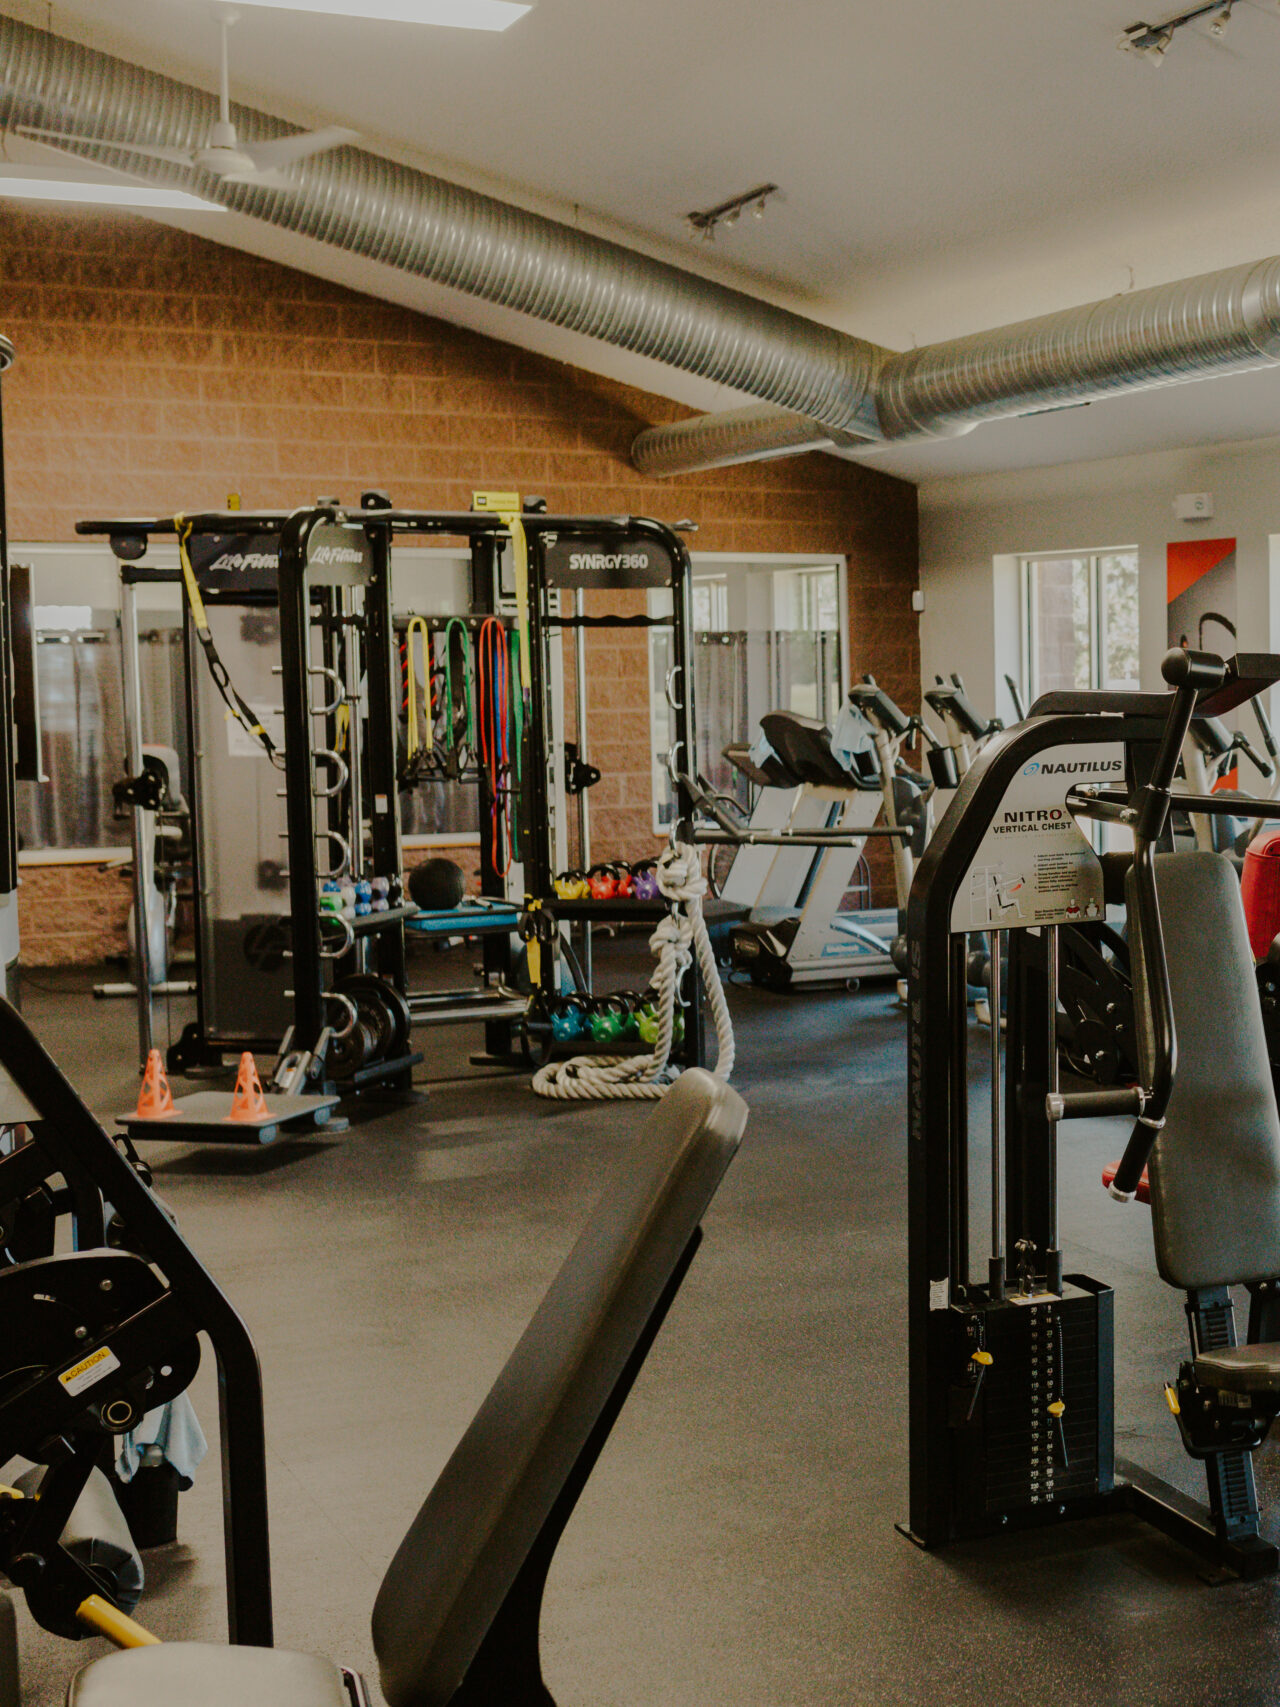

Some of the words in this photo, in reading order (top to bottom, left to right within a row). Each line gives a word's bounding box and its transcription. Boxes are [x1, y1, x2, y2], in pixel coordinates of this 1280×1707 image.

[569, 554, 649, 570] SYNRGY360
[1041, 760, 1122, 775] NAUTILUS
[1004, 809, 1062, 823] NITRO
[993, 823, 1039, 834] VERTICAL
[1042, 821, 1072, 831] CHEST
[70, 1351, 105, 1377] CAUTION
